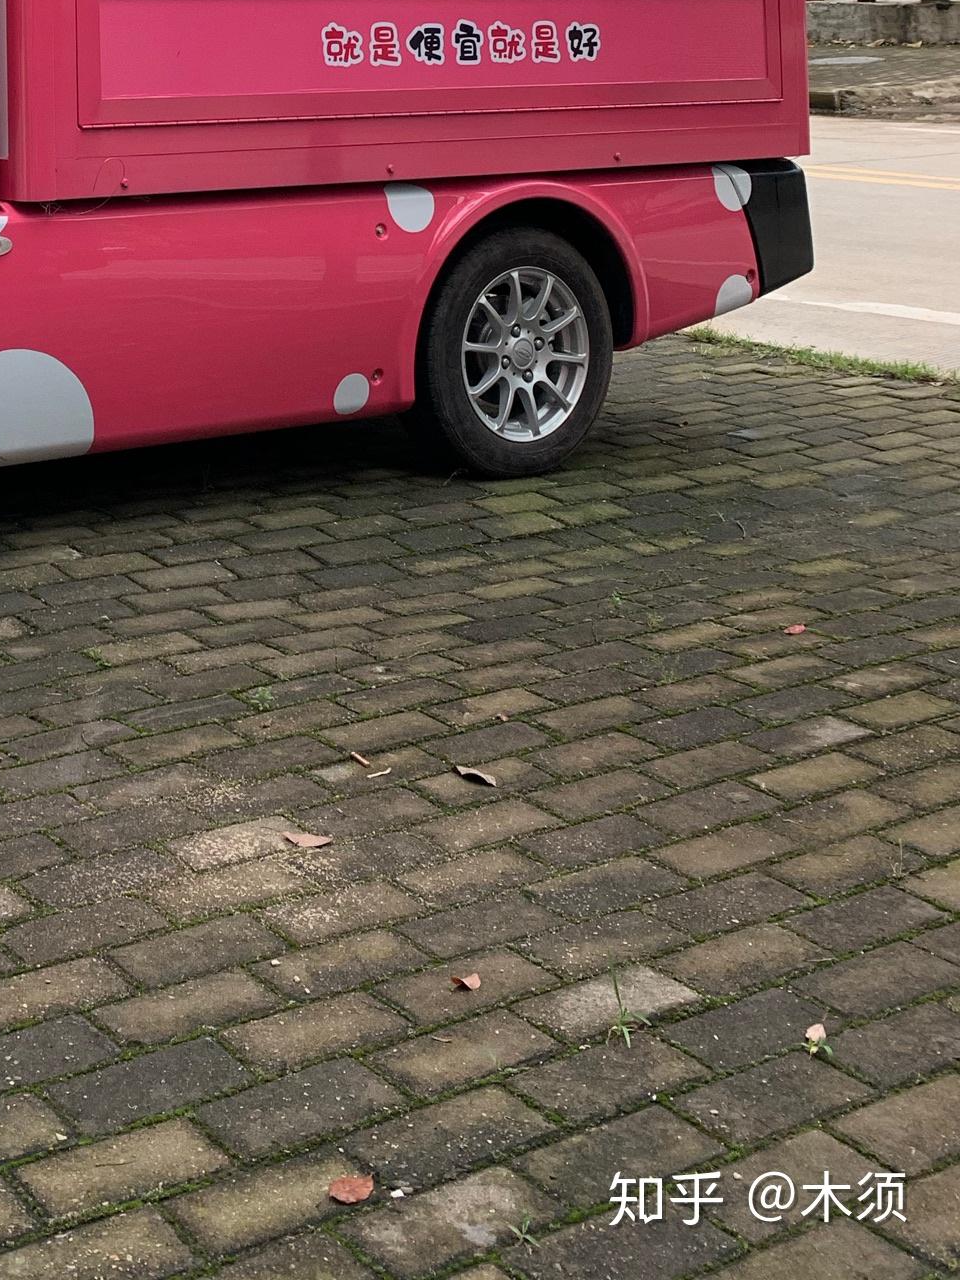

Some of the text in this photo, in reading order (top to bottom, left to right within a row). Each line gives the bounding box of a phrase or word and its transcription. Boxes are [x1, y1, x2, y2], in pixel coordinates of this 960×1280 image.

[324, 23, 599, 62] 就是便宜就是好
